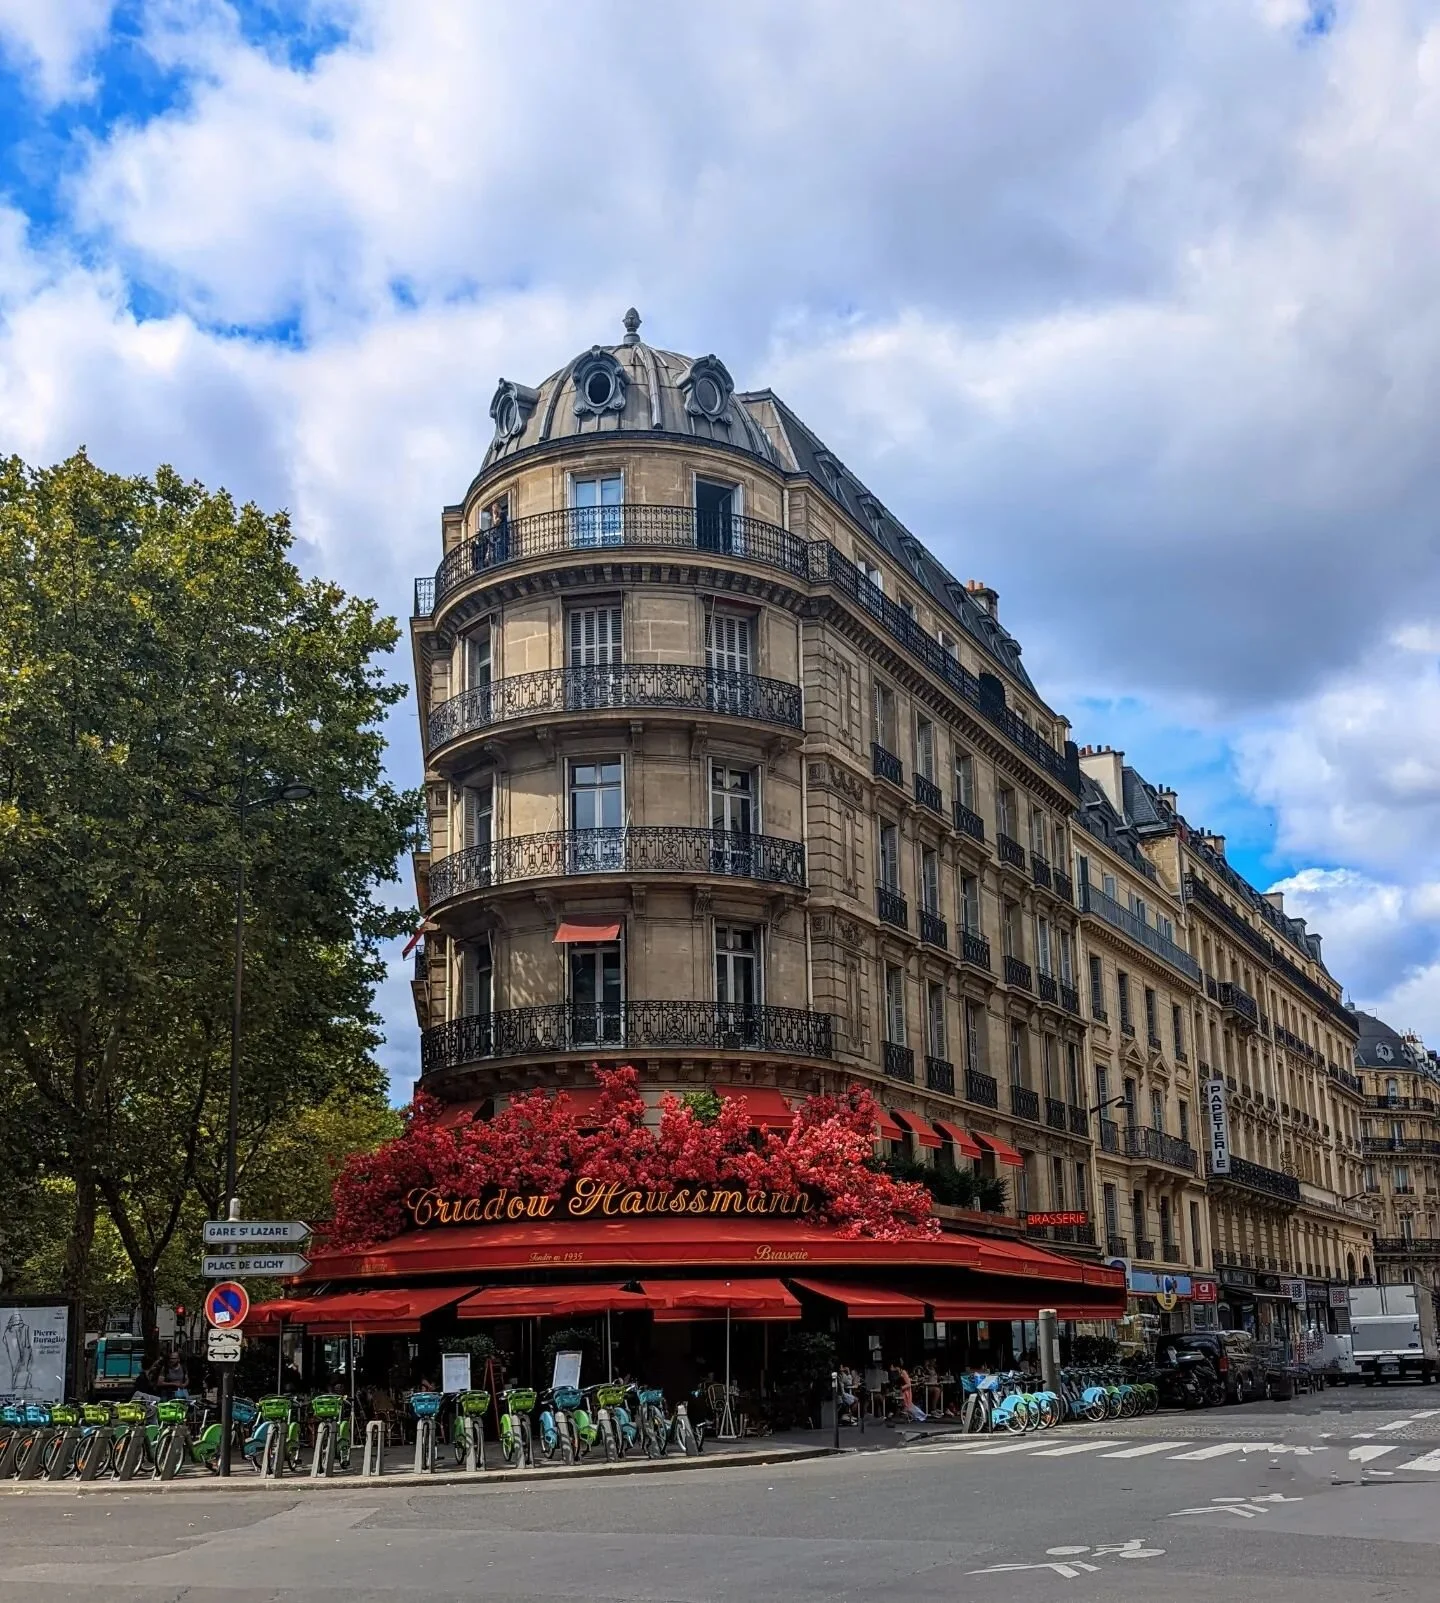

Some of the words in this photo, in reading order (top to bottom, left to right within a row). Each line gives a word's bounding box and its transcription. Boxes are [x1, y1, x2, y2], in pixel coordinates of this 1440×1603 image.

[1211, 1086, 1226, 1168] PAPETERIE
[568, 1177, 813, 1216] Haussmann
[1027, 1213, 1086, 1224] BRASSERIE
[209, 1228, 236, 1236] GARE
[754, 1244, 808, 1260] Brasserie
[208, 1262, 236, 1270] PLACE
[239, 1261, 251, 1269] DE
[254, 1261, 283, 1269] CLICHY
